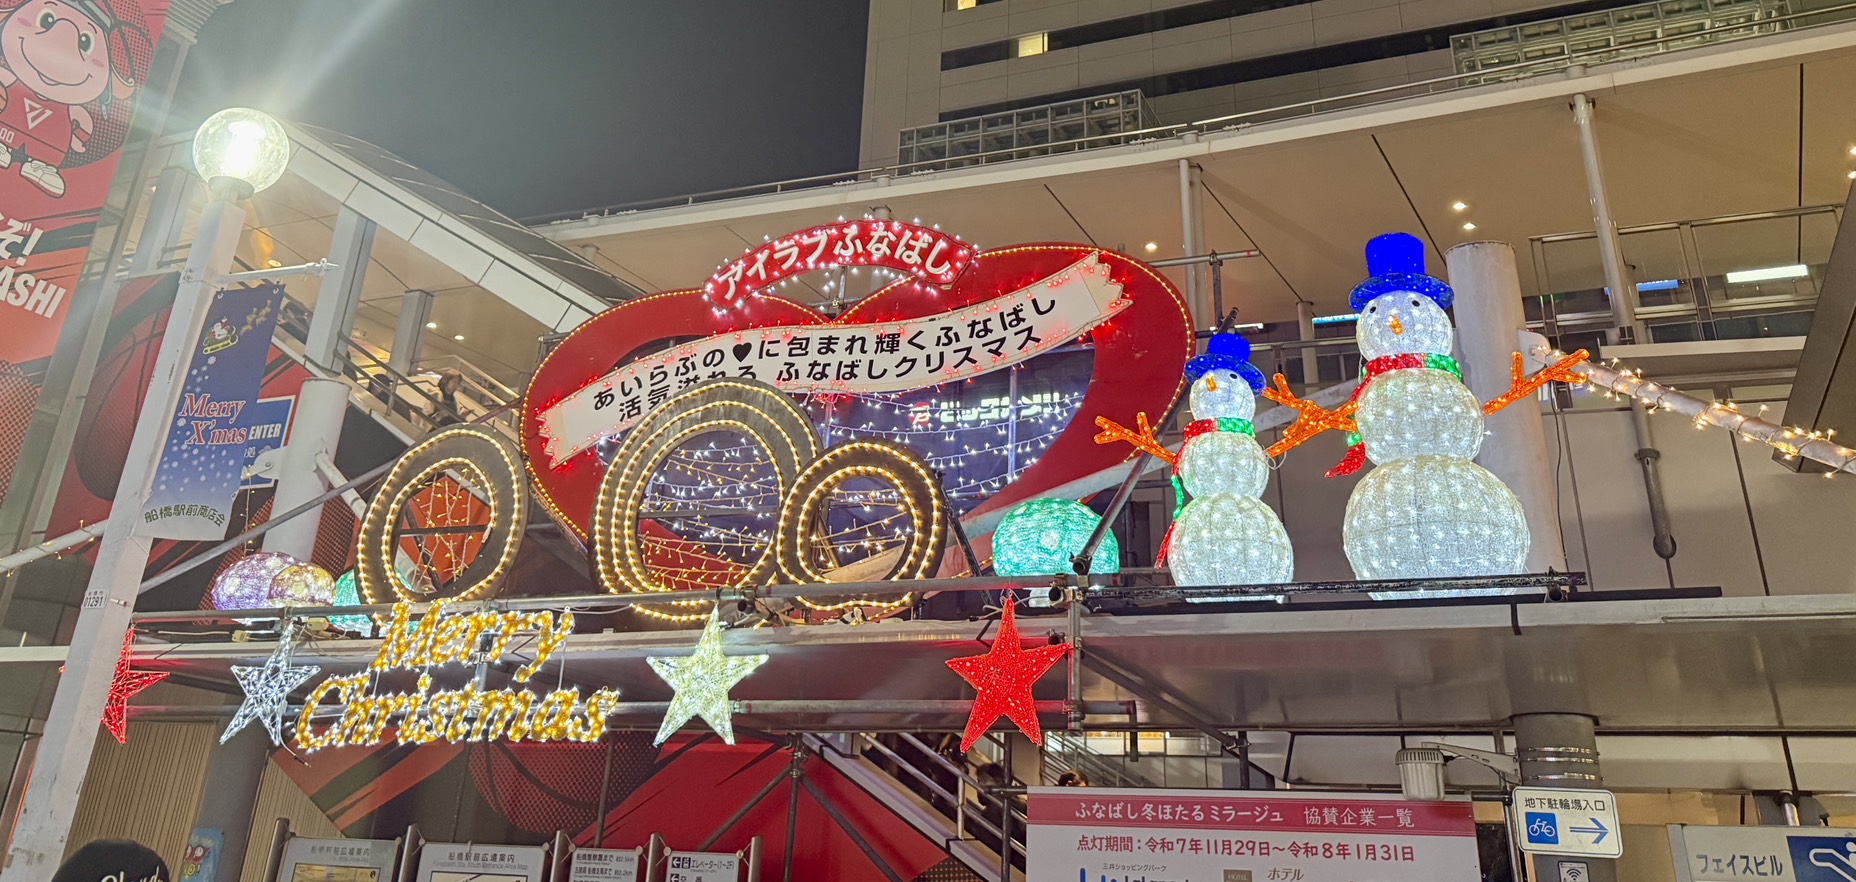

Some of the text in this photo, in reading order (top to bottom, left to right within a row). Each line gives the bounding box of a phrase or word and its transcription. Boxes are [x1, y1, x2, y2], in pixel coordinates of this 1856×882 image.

[0, 213, 44, 266] ぞ!
[718, 226, 952, 300] アイラブふなばし
[776, 326, 1042, 382] ふなばしクリスマス
[179, 394, 246, 425] Merry
[186, 421, 248, 446] X'mas
[248, 423, 282, 440] ENTER
[144, 504, 226, 527] 船橋駅前商店会
[370, 598, 575, 684] Merry
[294, 672, 621, 754] Christmas
[1525, 797, 1606, 811] 地下駐輪場入口
[1303, 806, 1415, 828] 協賛企業一覧
[1102, 863, 1167, 872] 三井ショッピングパーク
[1267, 867, 1304, 881] ホテル
[1696, 854, 1783, 876] フェイスビル
